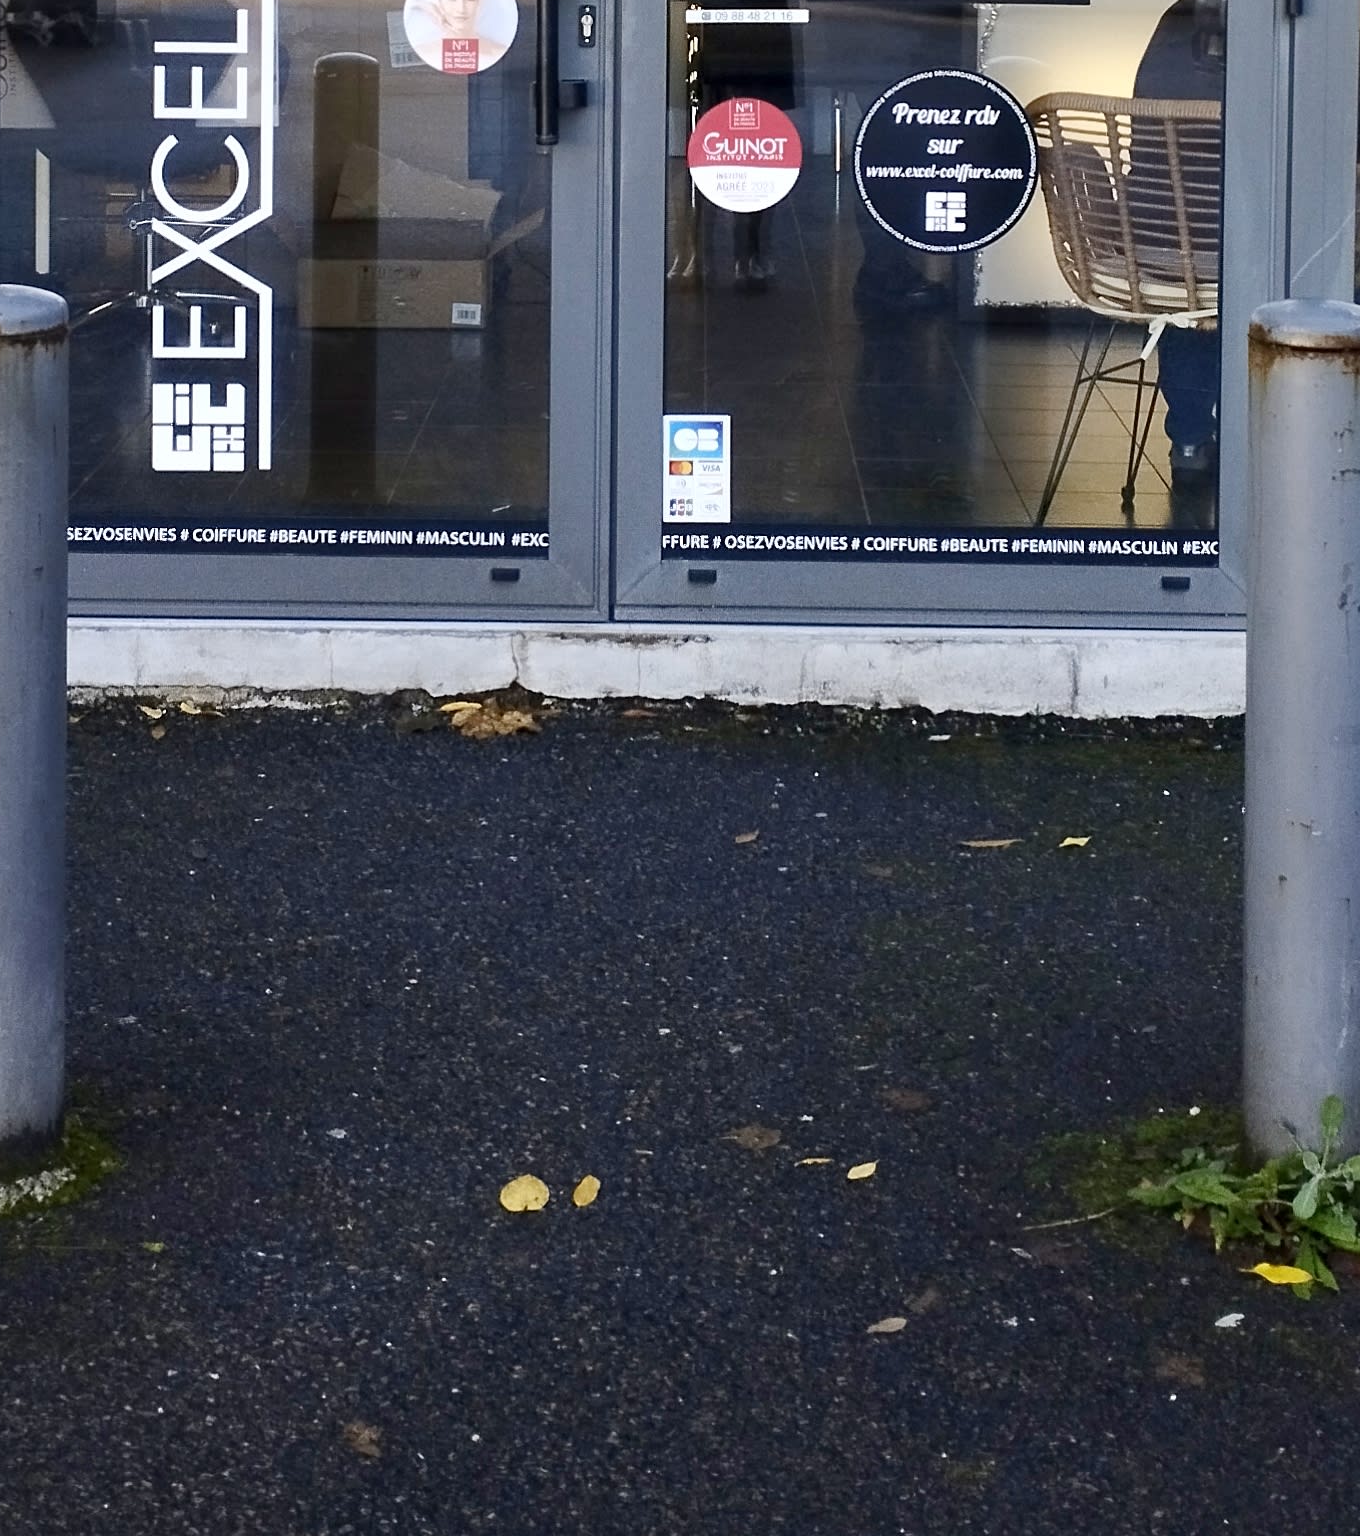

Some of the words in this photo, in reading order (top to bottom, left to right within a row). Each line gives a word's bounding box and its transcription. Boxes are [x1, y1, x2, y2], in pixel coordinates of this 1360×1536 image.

[747, 11, 761, 21] 48
[763, 11, 776, 21] 21
[781, 11, 793, 21] 16
[891, 102, 962, 125] Prenez
[964, 104, 1001, 125] rdv
[926, 138, 965, 155] sur
[865, 163, 1024, 183] www.excel-coiffure.com
[151, 8, 272, 359] EXCEL
[192, 528, 267, 543] COIFFURE
[269, 529, 337, 544] #BEAUTE
[339, 530, 413, 545] #FEMININ
[415, 530, 505, 546] #MASCULIN
[724, 534, 848, 551] OSEZVOSENVIES
[863, 536, 938, 552] COIFFURE
[940, 538, 1009, 553] #BEAUTE
[1011, 538, 1085, 554] #FEMININ
[1088, 539, 1178, 555] #MASCULIN
